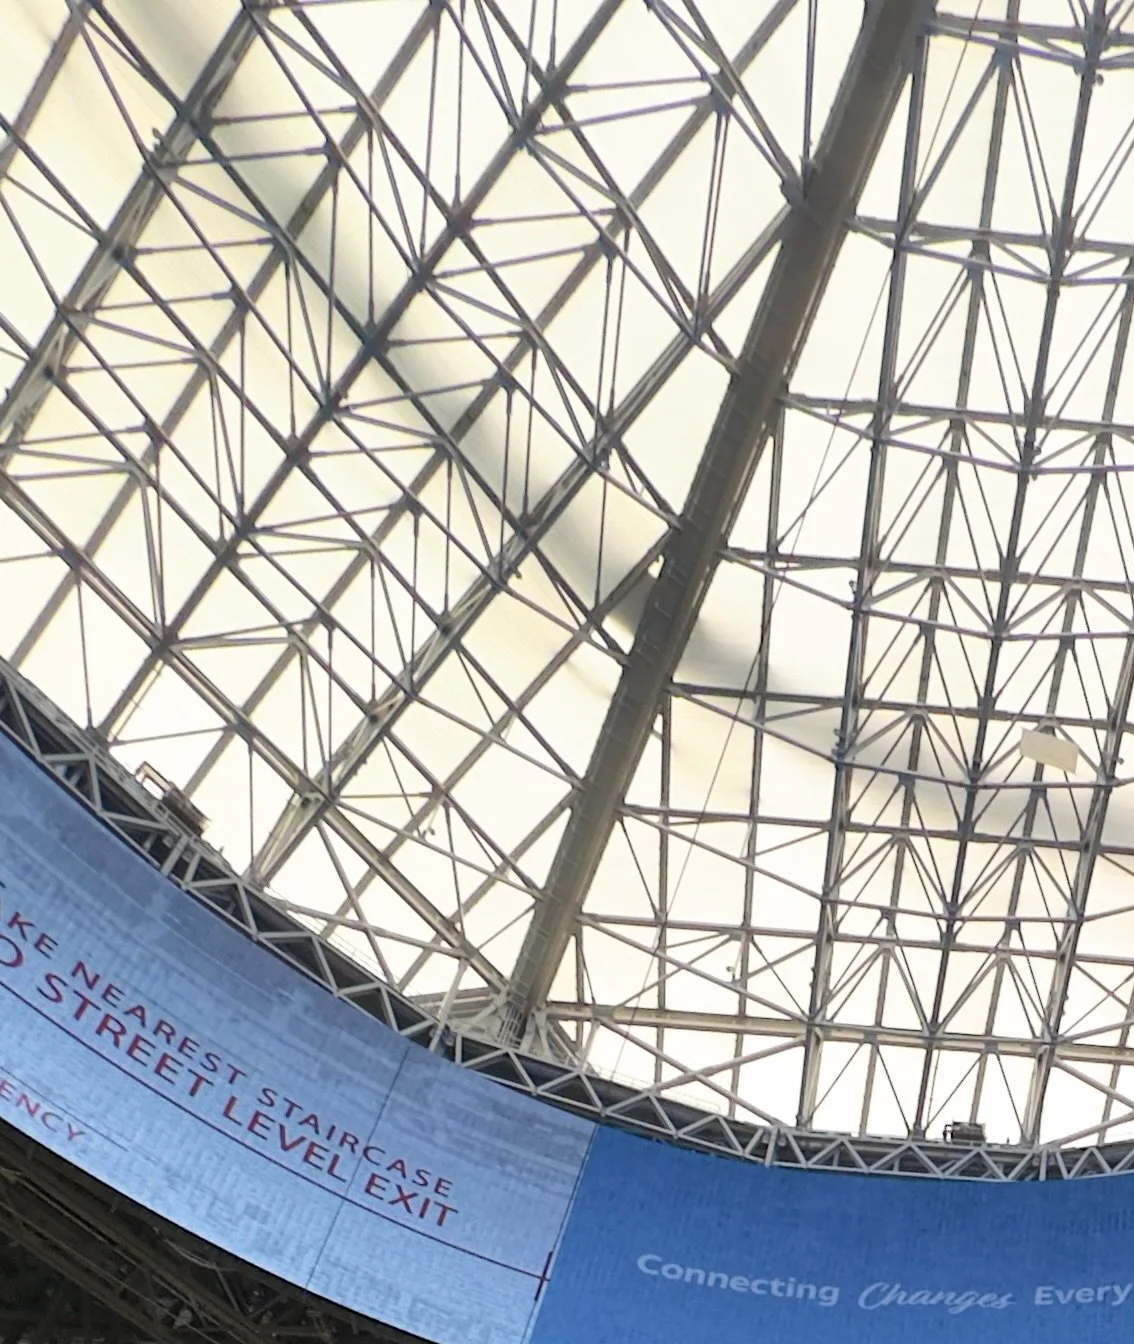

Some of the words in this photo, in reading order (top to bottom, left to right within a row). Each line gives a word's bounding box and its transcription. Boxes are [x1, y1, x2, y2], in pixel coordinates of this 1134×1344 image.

[37, 973, 214, 1097] STREET
[222, 1096, 347, 1183] LEVEL
[364, 1173, 459, 1227] EXIT
[71, 960, 247, 1084] NEAREST
[257, 1087, 453, 1198] STAIRCASE
[637, 1253, 840, 1307] Connecting
[858, 1281, 1016, 1315] Changes
